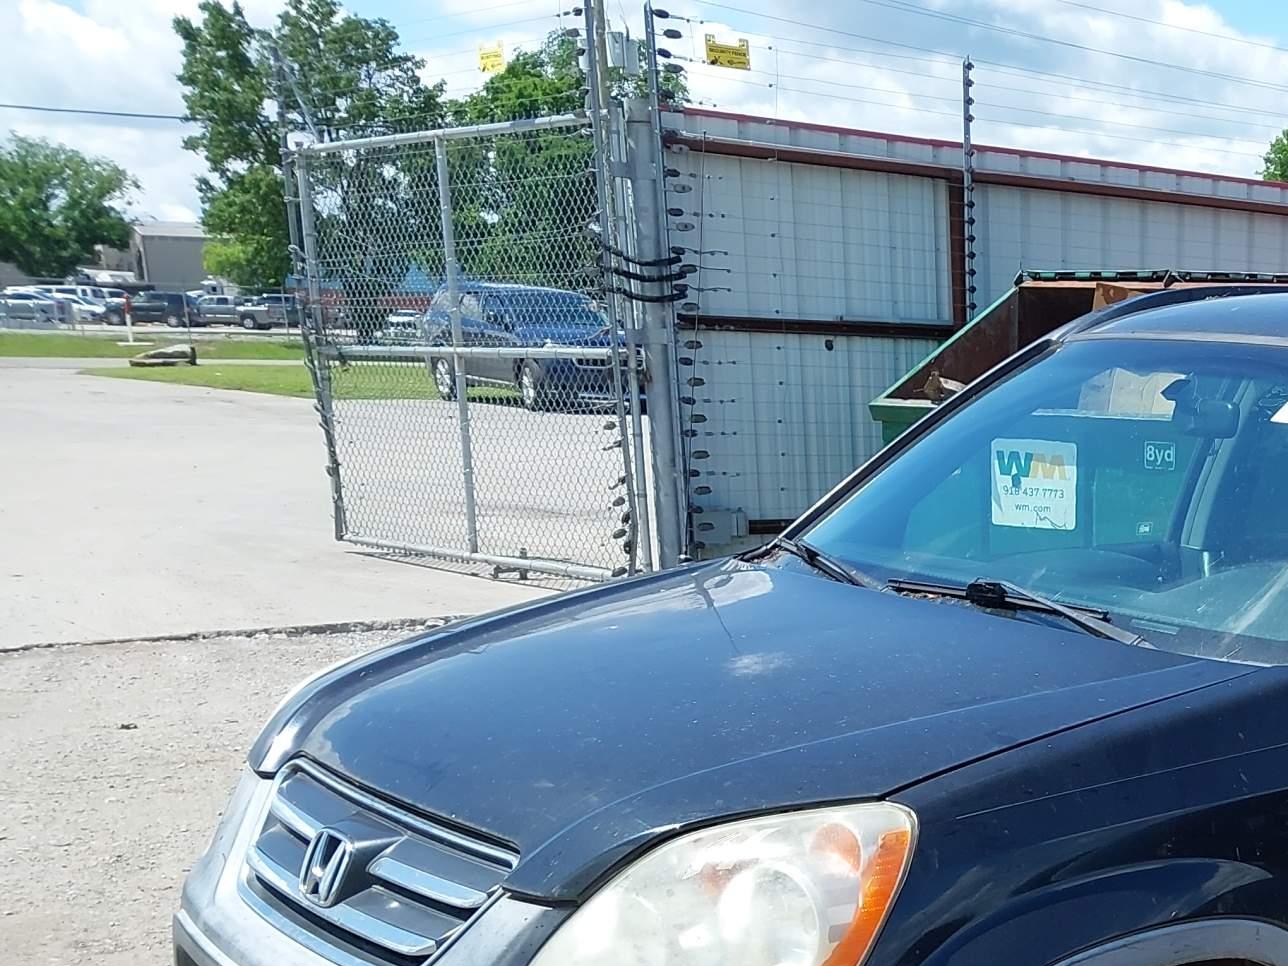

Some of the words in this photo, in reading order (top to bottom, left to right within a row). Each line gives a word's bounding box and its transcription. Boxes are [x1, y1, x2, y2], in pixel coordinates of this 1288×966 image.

[1146, 445, 1173, 465] 8yd
[996, 450, 1067, 480] WM
[1022, 487, 1040, 497] 437
[1042, 488, 1064, 499] 7773
[1015, 503, 1051, 513] wm.com
